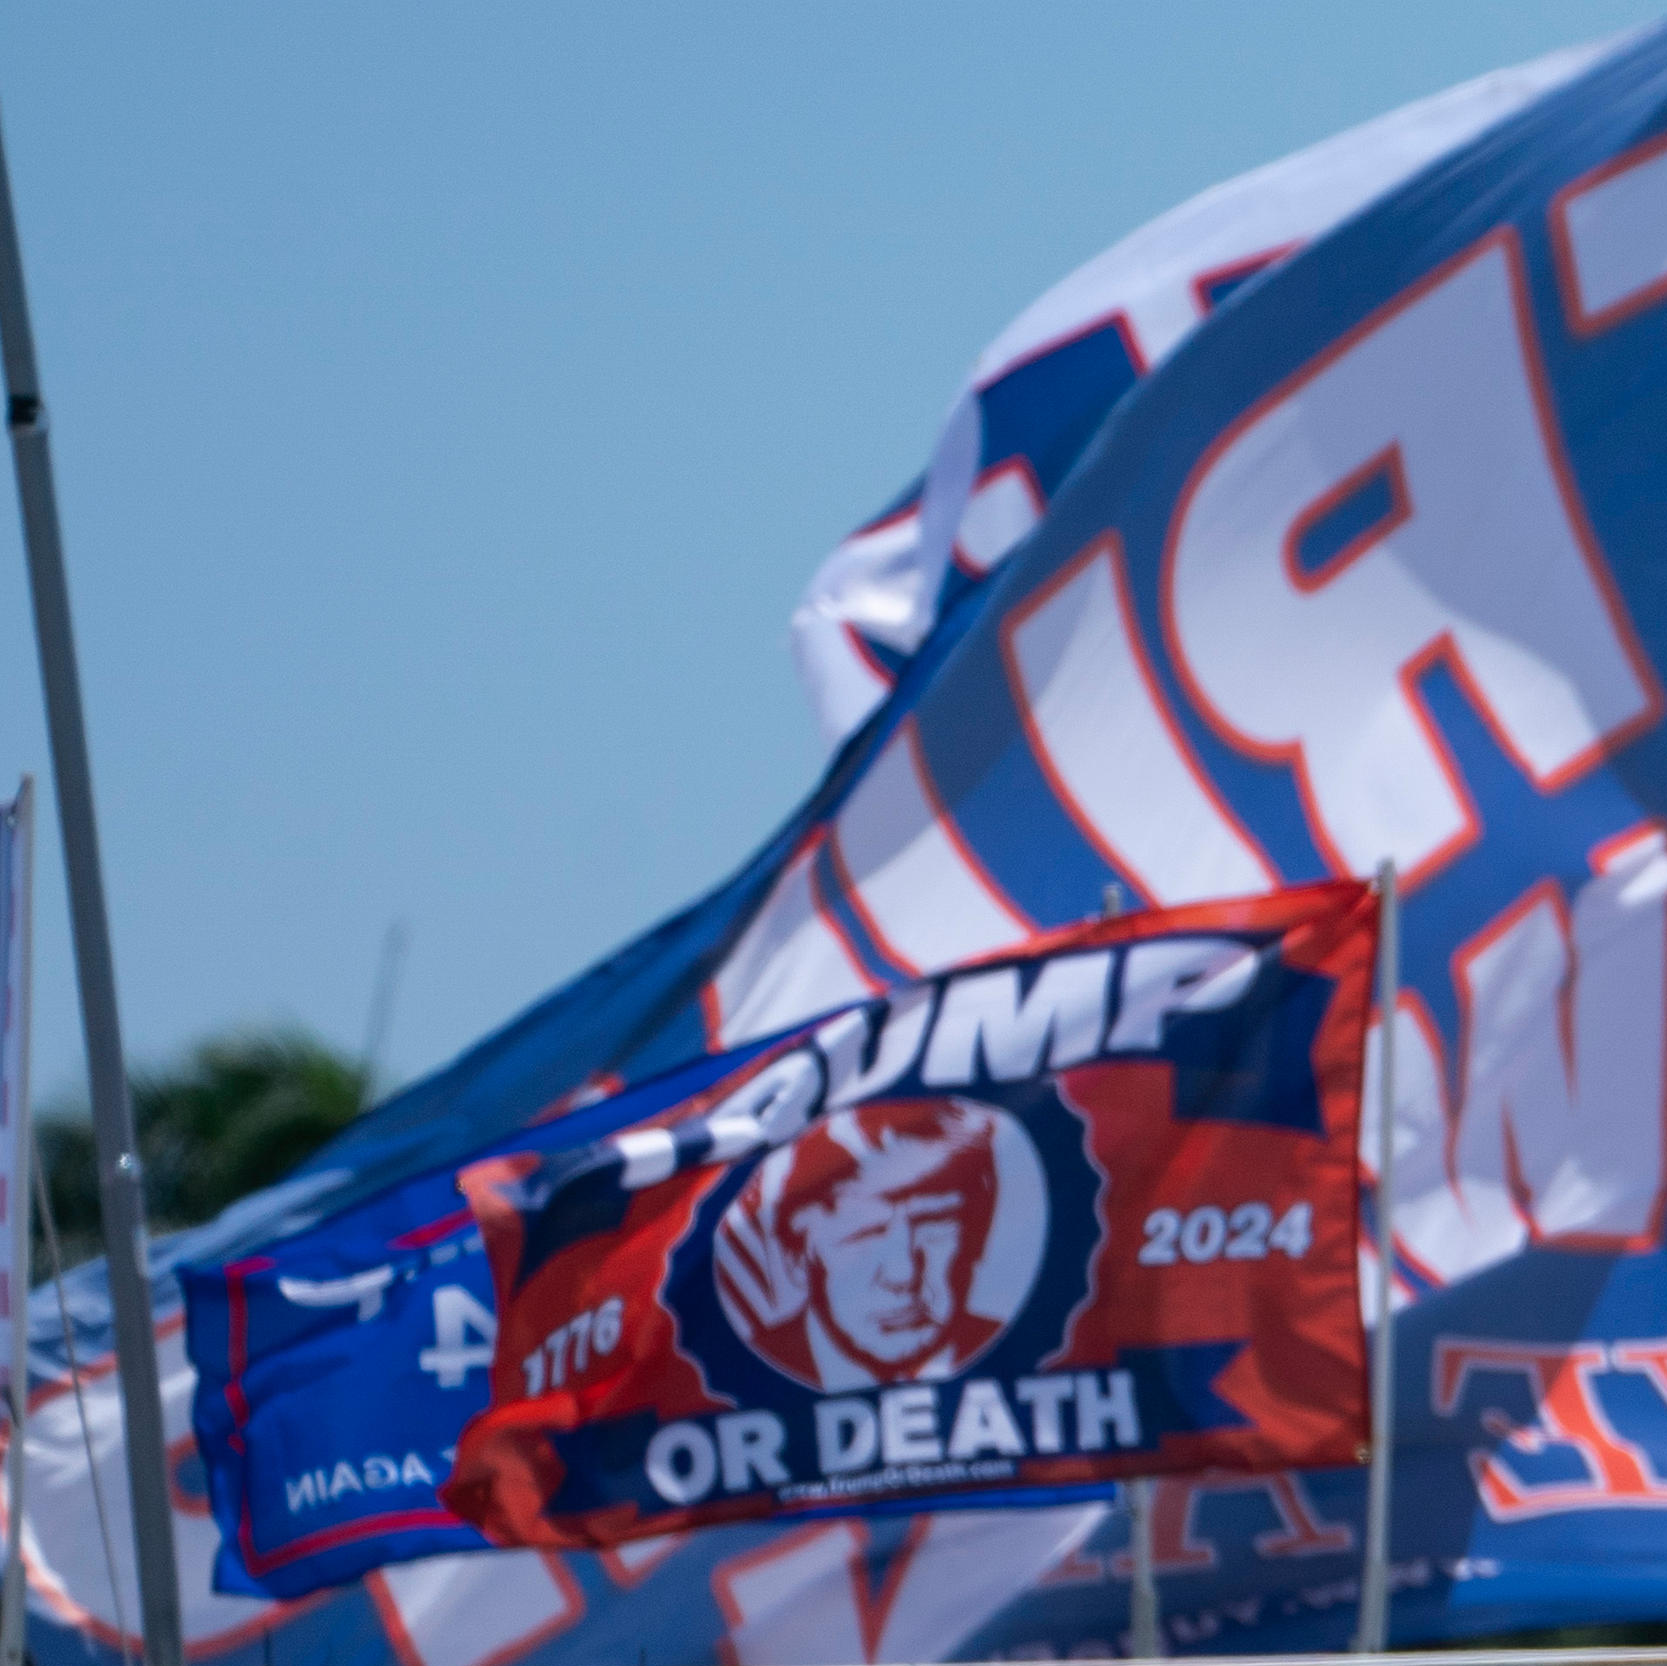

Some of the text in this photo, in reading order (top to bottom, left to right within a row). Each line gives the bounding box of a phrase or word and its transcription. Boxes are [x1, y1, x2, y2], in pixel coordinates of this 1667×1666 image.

[1137, 1203, 1313, 1266] 2024
[522, 1296, 624, 1398] 1776
[645, 1369, 1141, 1505] OR DEATH
